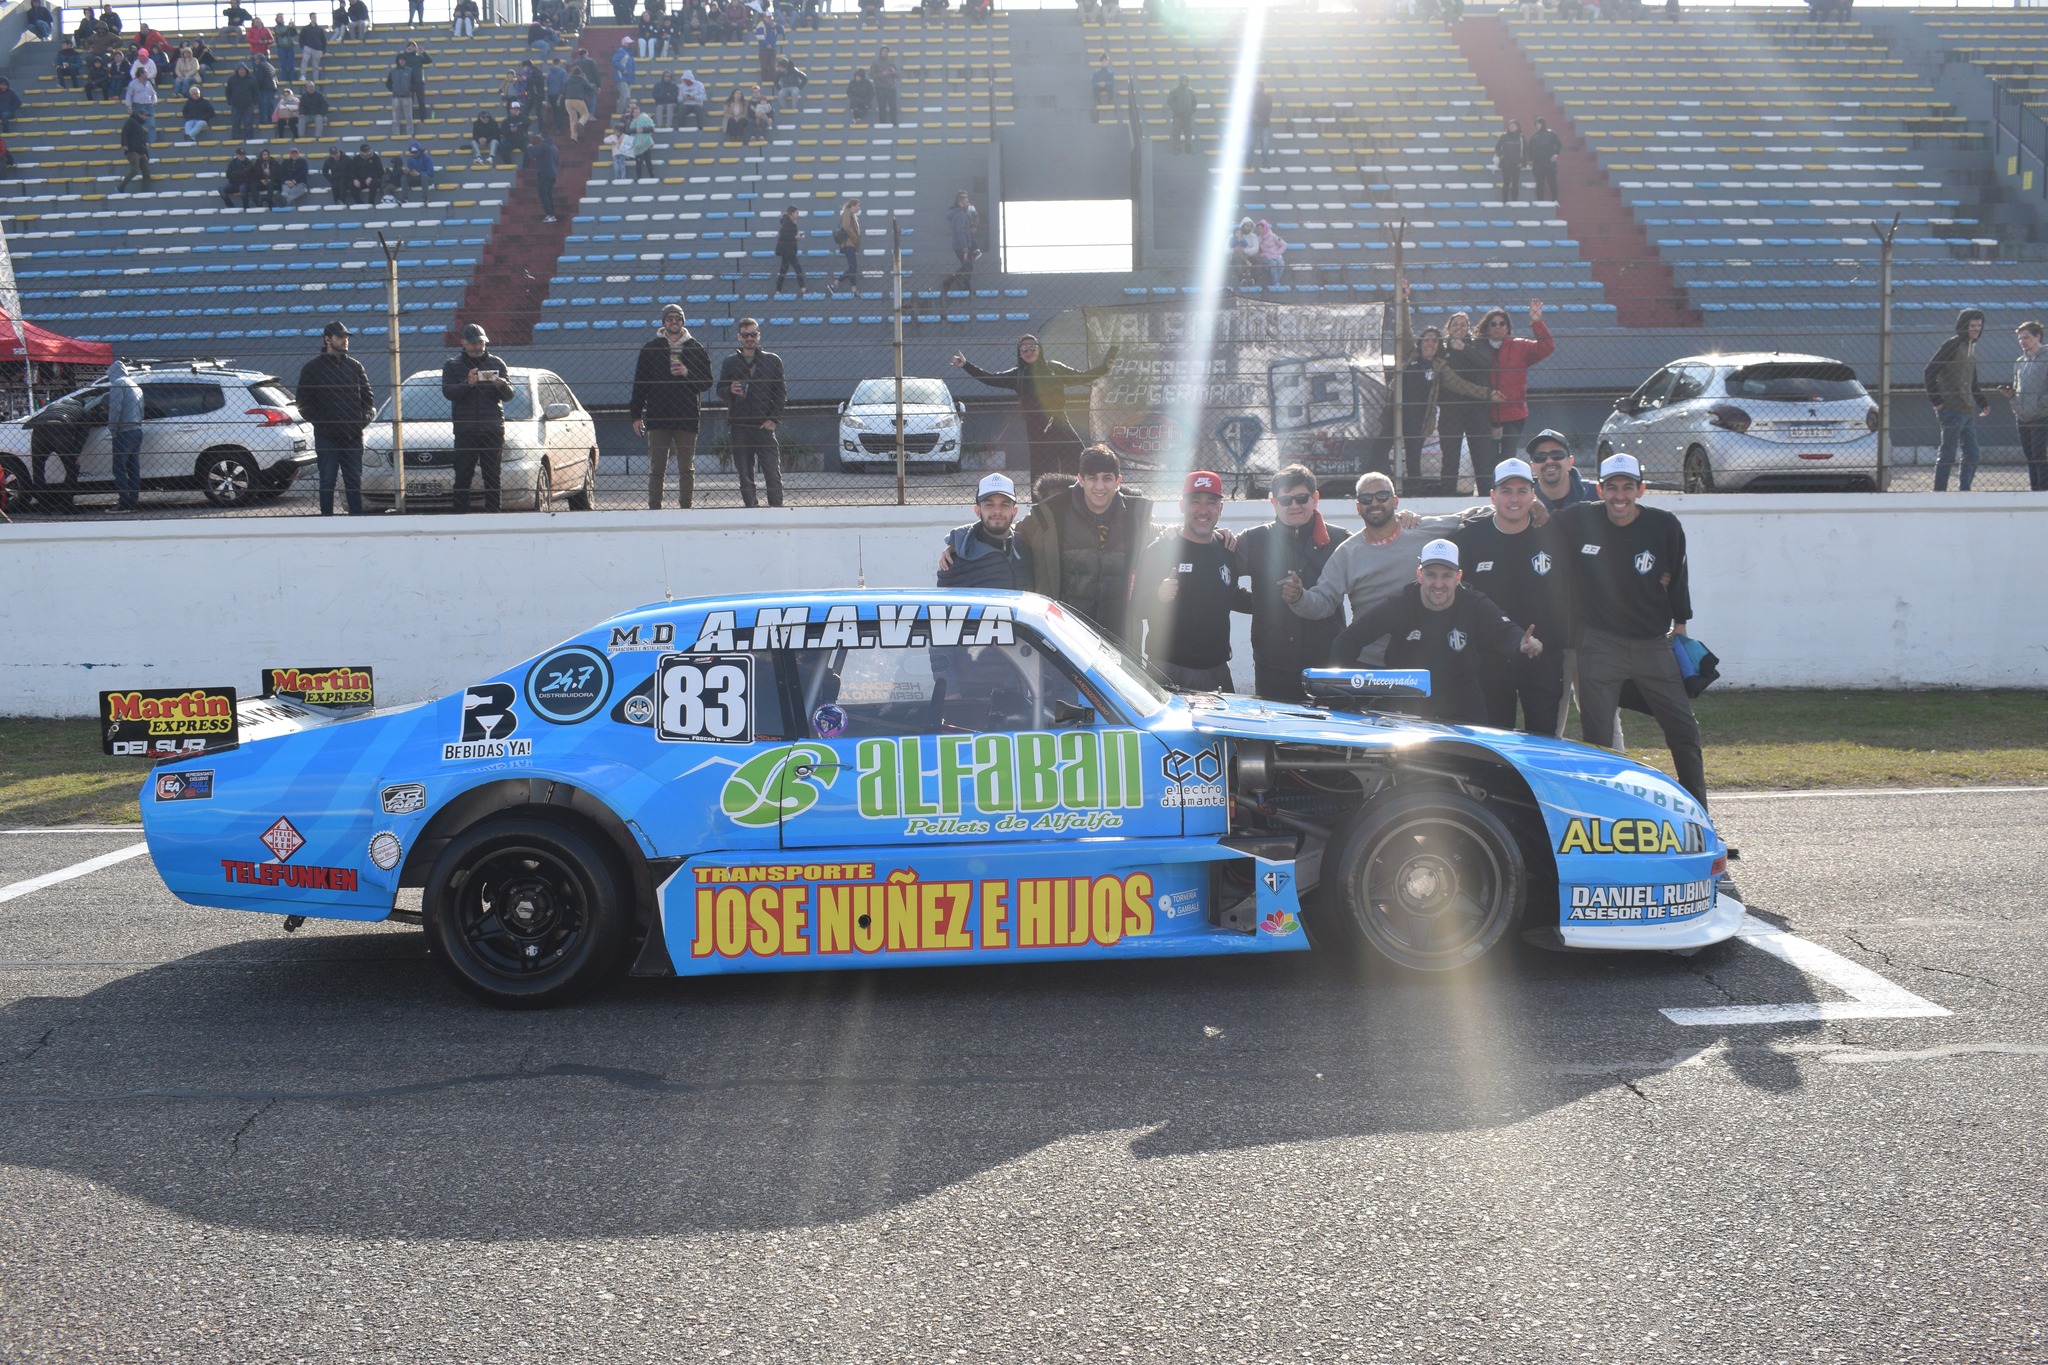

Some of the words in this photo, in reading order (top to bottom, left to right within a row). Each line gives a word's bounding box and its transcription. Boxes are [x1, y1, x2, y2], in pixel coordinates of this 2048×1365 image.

[272, 668, 371, 693] Martin
[305, 691, 371, 703] EXPRESS
[538, 691, 595, 699] DISTRIBUIDORA
[663, 665, 747, 738] 83
[108, 691, 232, 722] Martin
[150, 718, 231, 735] EXPRESS
[444, 743, 504, 760] BEBIDAS
[509, 741, 532, 756] YA!
[1166, 784, 1222, 796] electro
[1161, 796, 1226, 807] diamante
[905, 819, 990, 836] Pellets
[996, 814, 1027, 832] de
[1030, 811, 1124, 833] Alfalfa
[221, 859, 358, 892] TELEFUNKEN
[691, 862, 876, 884] TRANSPORTE
[1571, 885, 1657, 908] DANIEL
[1663, 879, 1712, 904] RUBINO
[691, 883, 809, 958] JOSE
[817, 866, 974, 953] NUÑEZ
[980, 879, 1010, 950] E
[1017, 871, 1155, 949] HIJOS
[1177, 902, 1200, 914] GAMBALE
[1568, 907, 1642, 921] ASESOR
[1647, 905, 1667, 919] DE
[1669, 899, 1711, 917] SEGUROS
